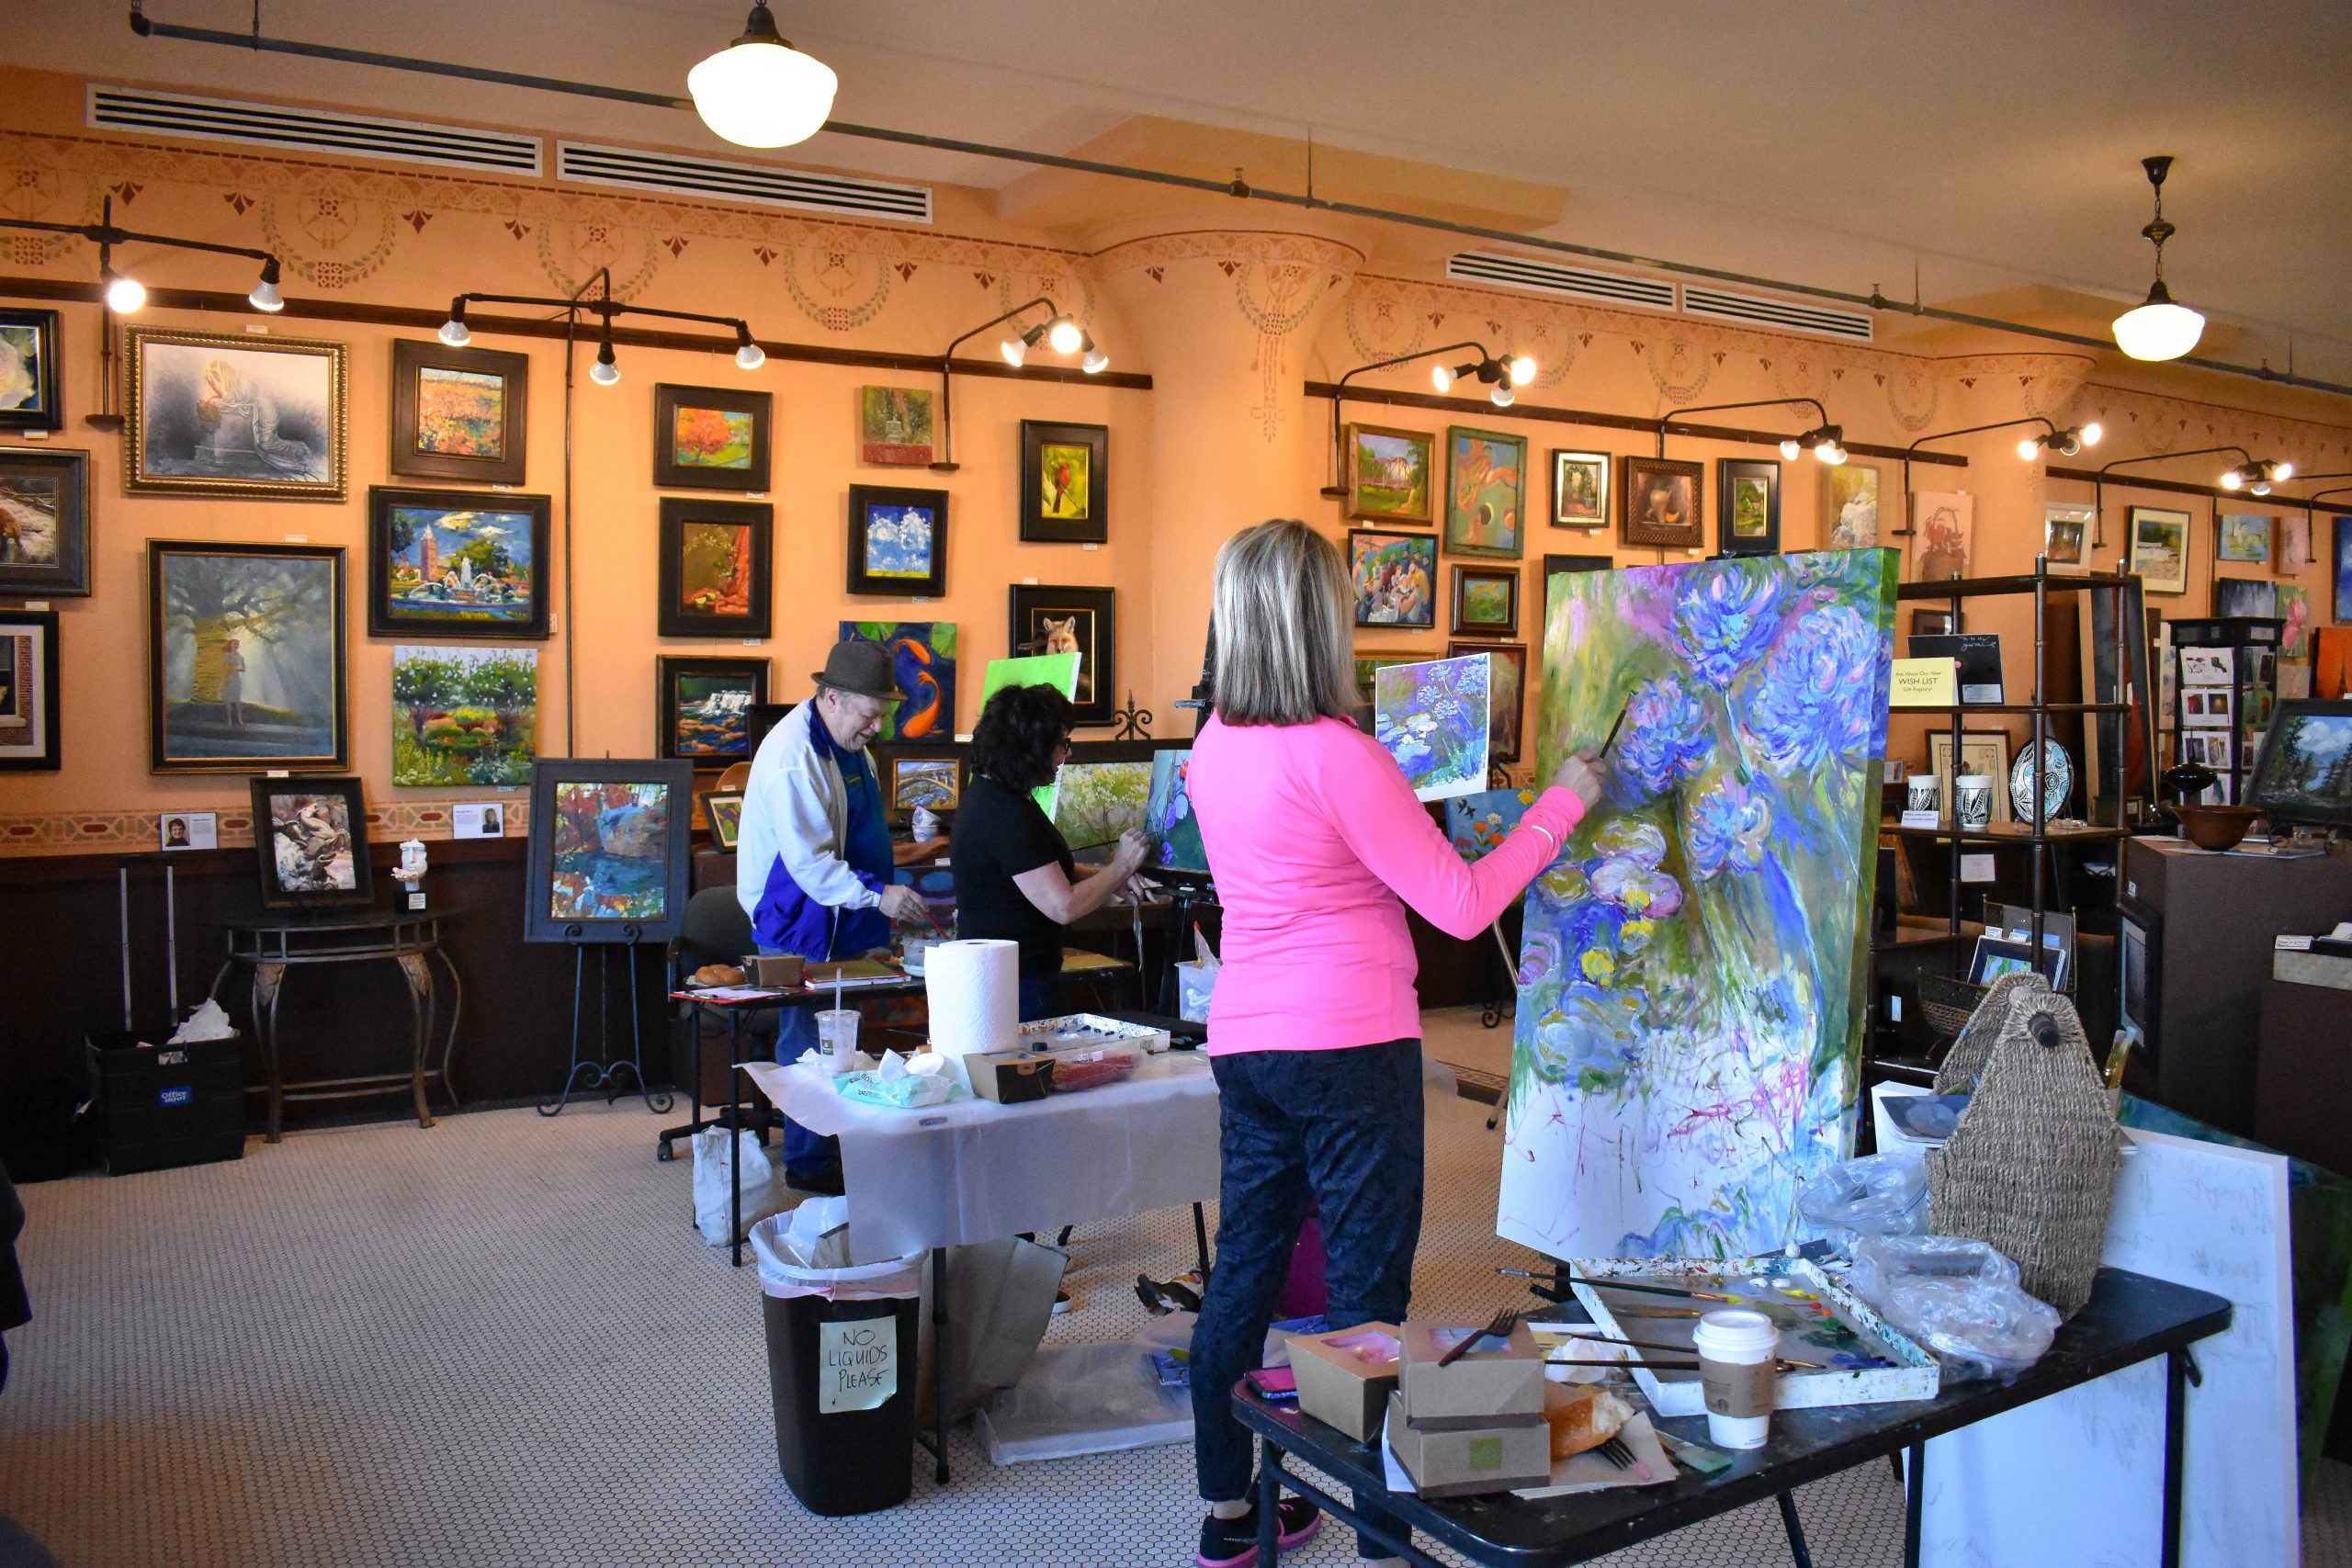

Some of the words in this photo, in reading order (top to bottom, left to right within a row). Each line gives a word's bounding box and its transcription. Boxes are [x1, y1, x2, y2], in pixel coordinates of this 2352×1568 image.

[1922, 677, 1939, 685] LIST
[161, 1090, 187, 1099] Office
[842, 1328, 876, 1346] NO
[829, 1345, 888, 1367] LIQUIDS
[839, 1368, 889, 1393] PLEASE
